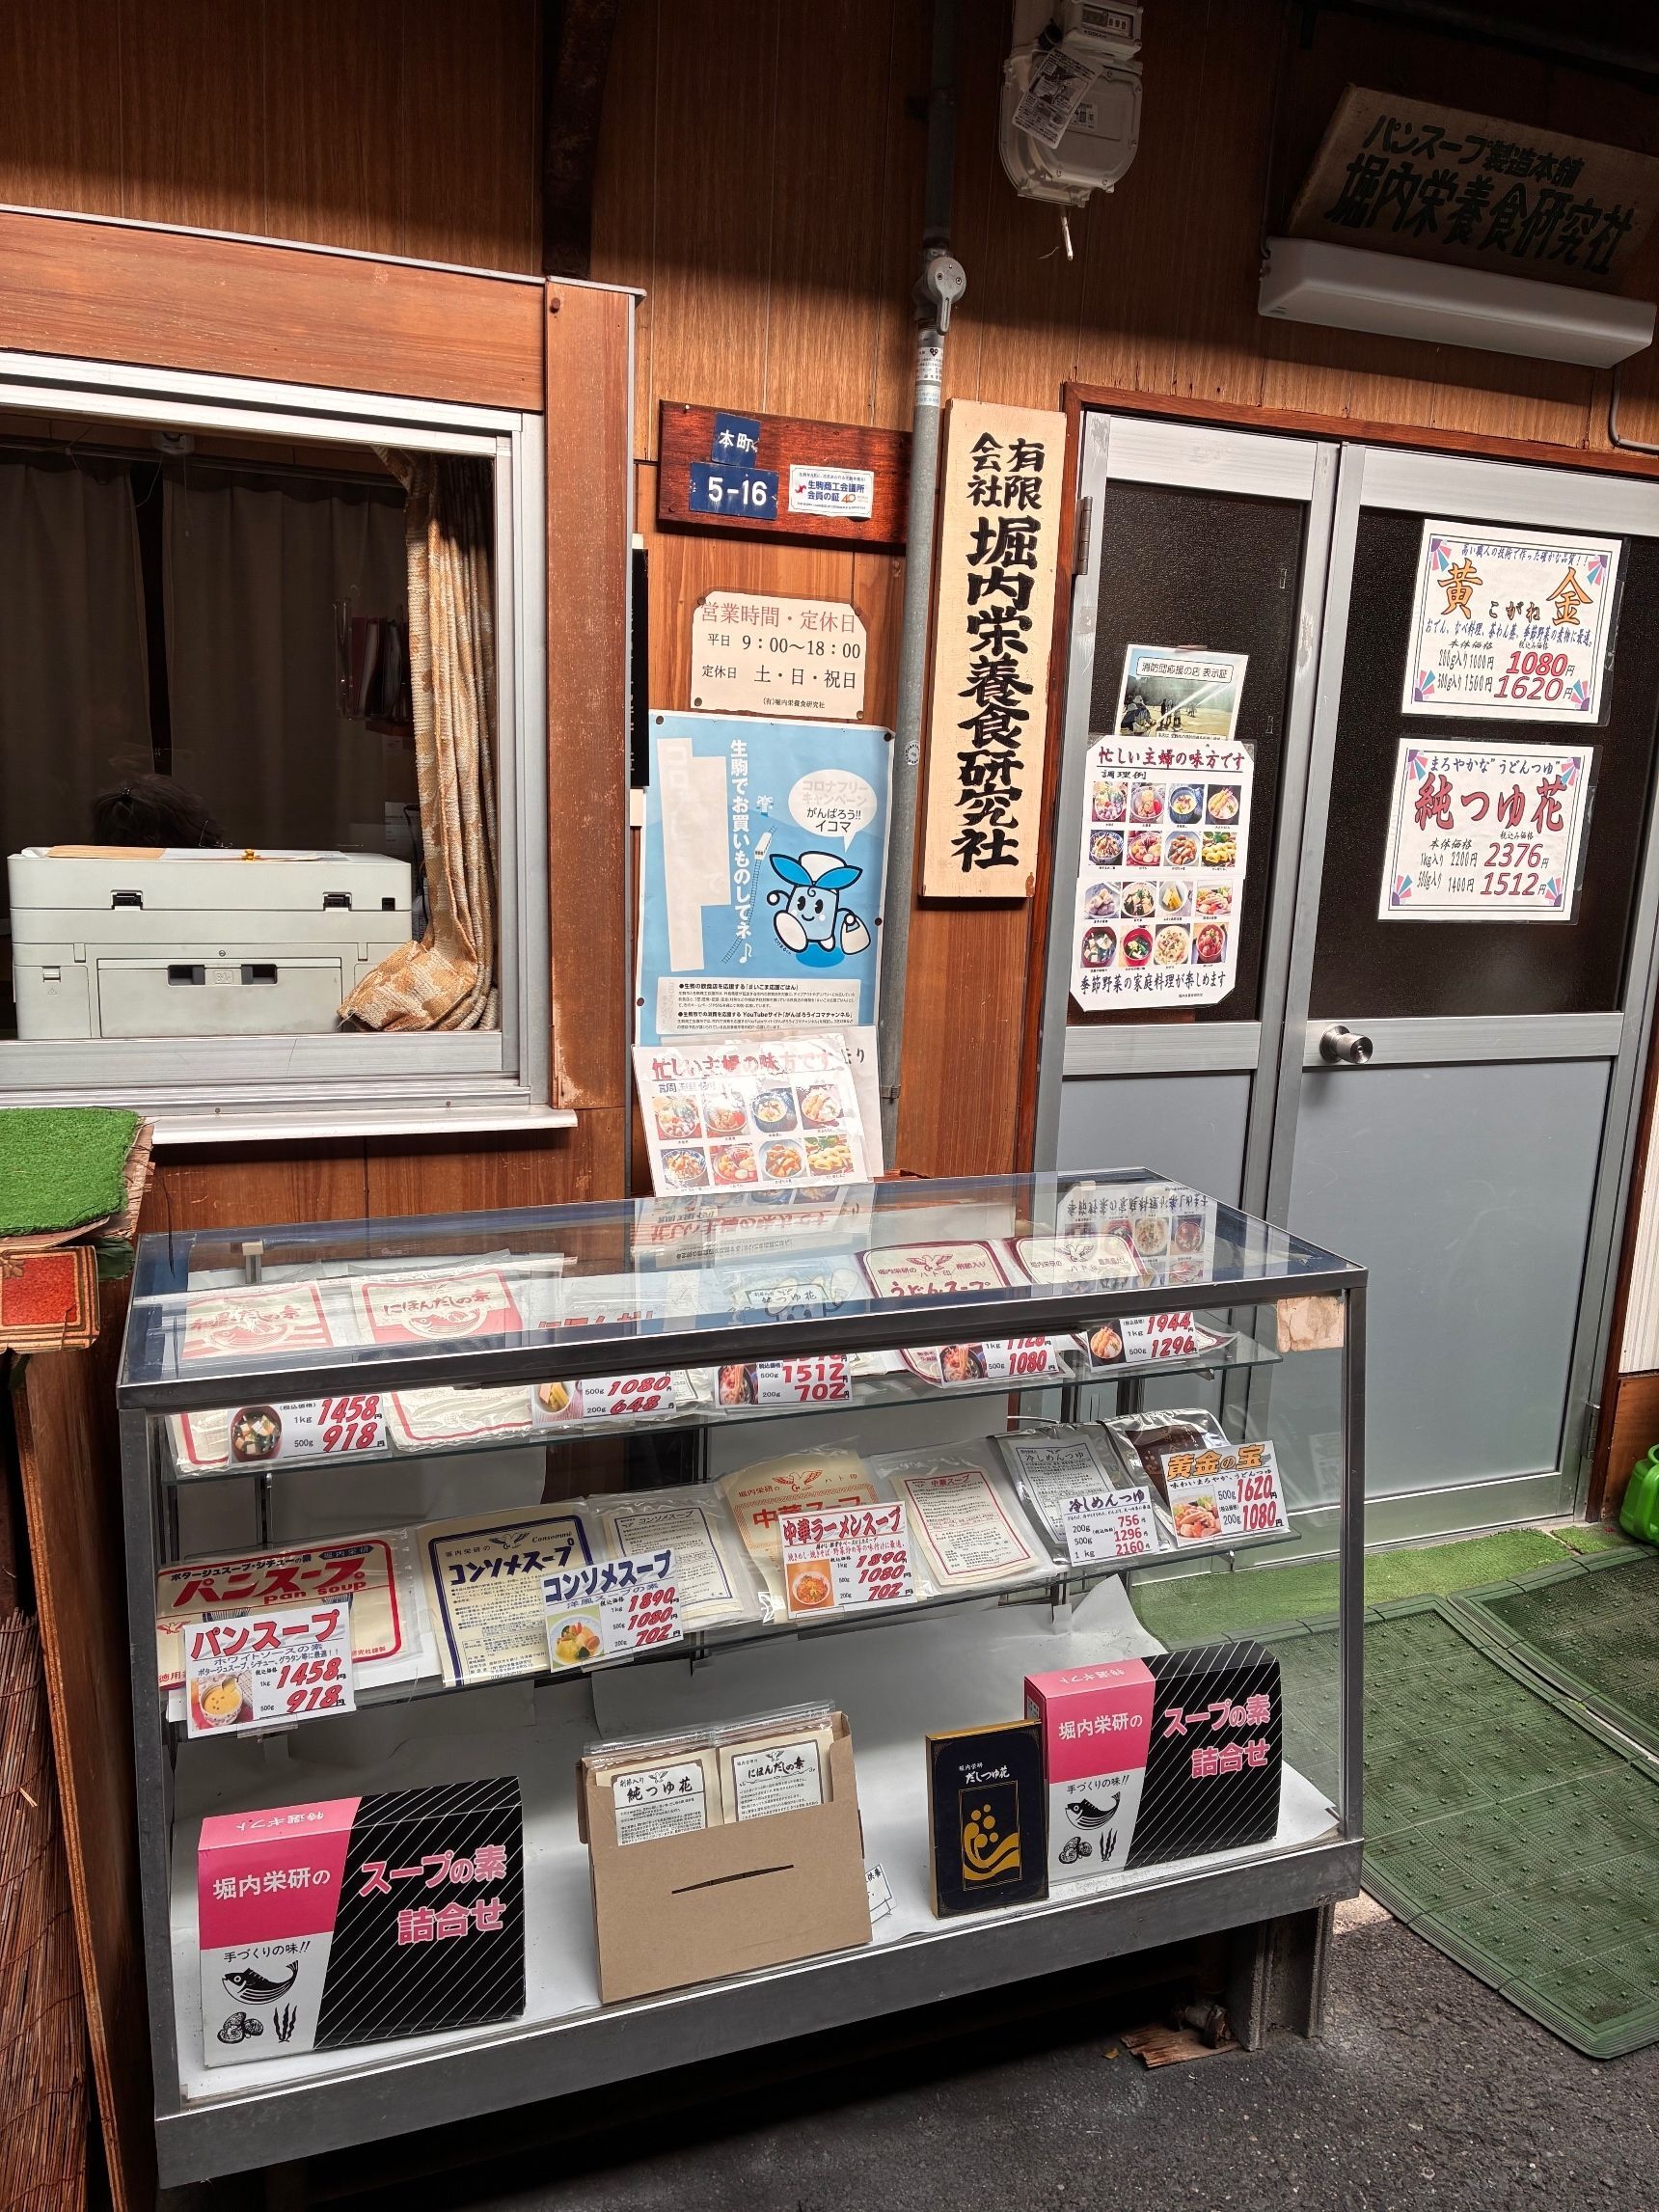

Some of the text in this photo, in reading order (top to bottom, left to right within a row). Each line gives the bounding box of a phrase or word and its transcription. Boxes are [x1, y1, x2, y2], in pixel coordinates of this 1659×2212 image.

[1362, 114, 1585, 188] パンスープ製造本舗
[1323, 152, 1636, 275] 堀内栄養食研究社
[719, 428, 754, 453] 本町
[966, 431, 1004, 508] 会社
[1004, 438, 1045, 511] 有限
[707, 475, 769, 507] 5-16
[807, 479, 865, 494] 生駒商工会議所
[807, 490, 840, 503] 会員の証
[1436, 558, 1594, 626] 黄 こがね 金
[700, 601, 857, 634] 営業時間・定休日
[707, 633, 730, 647] 平日
[1449, 640, 1494, 650] 本体価格
[701, 665, 738, 679] 定休日
[1506, 650, 1576, 677] 1080円
[950, 514, 1042, 873] 堀内栄養食研究社
[1493, 674, 1574, 700] 1620円
[1098, 746, 1246, 771] 忙しい主婦の味方です
[1413, 771, 1568, 834] 純つゆ花
[814, 820, 852, 834] イコマ
[1429, 838, 1473, 851] 本体価格
[1483, 842, 1550, 869] 2376円
[1450, 851, 1479, 868] 2200円
[1480, 872, 1547, 896] 1512円
[1079, 969, 1227, 996] 季節野菜の家庭料理が楽しめます
[383, 1288, 492, 1316] にほんだしの素
[1151, 1335, 1198, 1358] 1296円
[781, 1362, 849, 1383] 1512円
[1008, 1350, 1056, 1376] 1080円
[585, 1375, 673, 1397] 500g 1080円
[762, 1382, 851, 1402] 200g 702円
[293, 1395, 384, 1426] 1kg 1458円
[586, 1395, 675, 1415] 200g 648円
[293, 1422, 386, 1454] 500g 918円
[1025, 1452, 1084, 1462] 冷しめんつゆ
[1167, 1443, 1265, 1482] 黄金の宝
[1069, 1488, 1146, 1513] 冷しめんつゆ
[1217, 1474, 1278, 1503] 500g 1620円
[639, 1510, 694, 1524] コンソメスープ
[782, 1506, 901, 1546] 中華ラーメンスープ
[1072, 1524, 1091, 1534] 200g
[1223, 1501, 1285, 1531] 200g 1080円
[1074, 1537, 1093, 1545] 500g
[448, 1538, 575, 1587] コンソメスープ
[856, 1549, 908, 1569] 1890円
[172, 1557, 367, 1608] パンスープ
[543, 1549, 672, 1602] コンソメスープ
[857, 1565, 912, 1584] 1080円
[263, 1581, 367, 1605] pan soup
[628, 1587, 680, 1613] 1890円
[867, 1582, 914, 1601] 702円
[628, 1606, 678, 1631] 1080円
[190, 1608, 340, 1660] パンスープ
[636, 1624, 681, 1648] 702円
[213, 1643, 323, 1666] ホワイトソースの素
[277, 1656, 347, 1689] 1458円
[286, 1684, 346, 1714] 918円
[1058, 1711, 1144, 1741] 堀内栄研の
[1162, 1693, 1271, 1739] スープの素
[748, 1756, 806, 1779] にほんだしの素
[1190, 1737, 1271, 1780] 詰合せ
[965, 1764, 1011, 1785] だしつゆ花
[626, 1776, 694, 1804] 純つゆ花
[212, 1866, 332, 1901] 堀内栄研の
[359, 1843, 507, 1898] スープの素
[396, 1897, 507, 1947] 詰合せ
